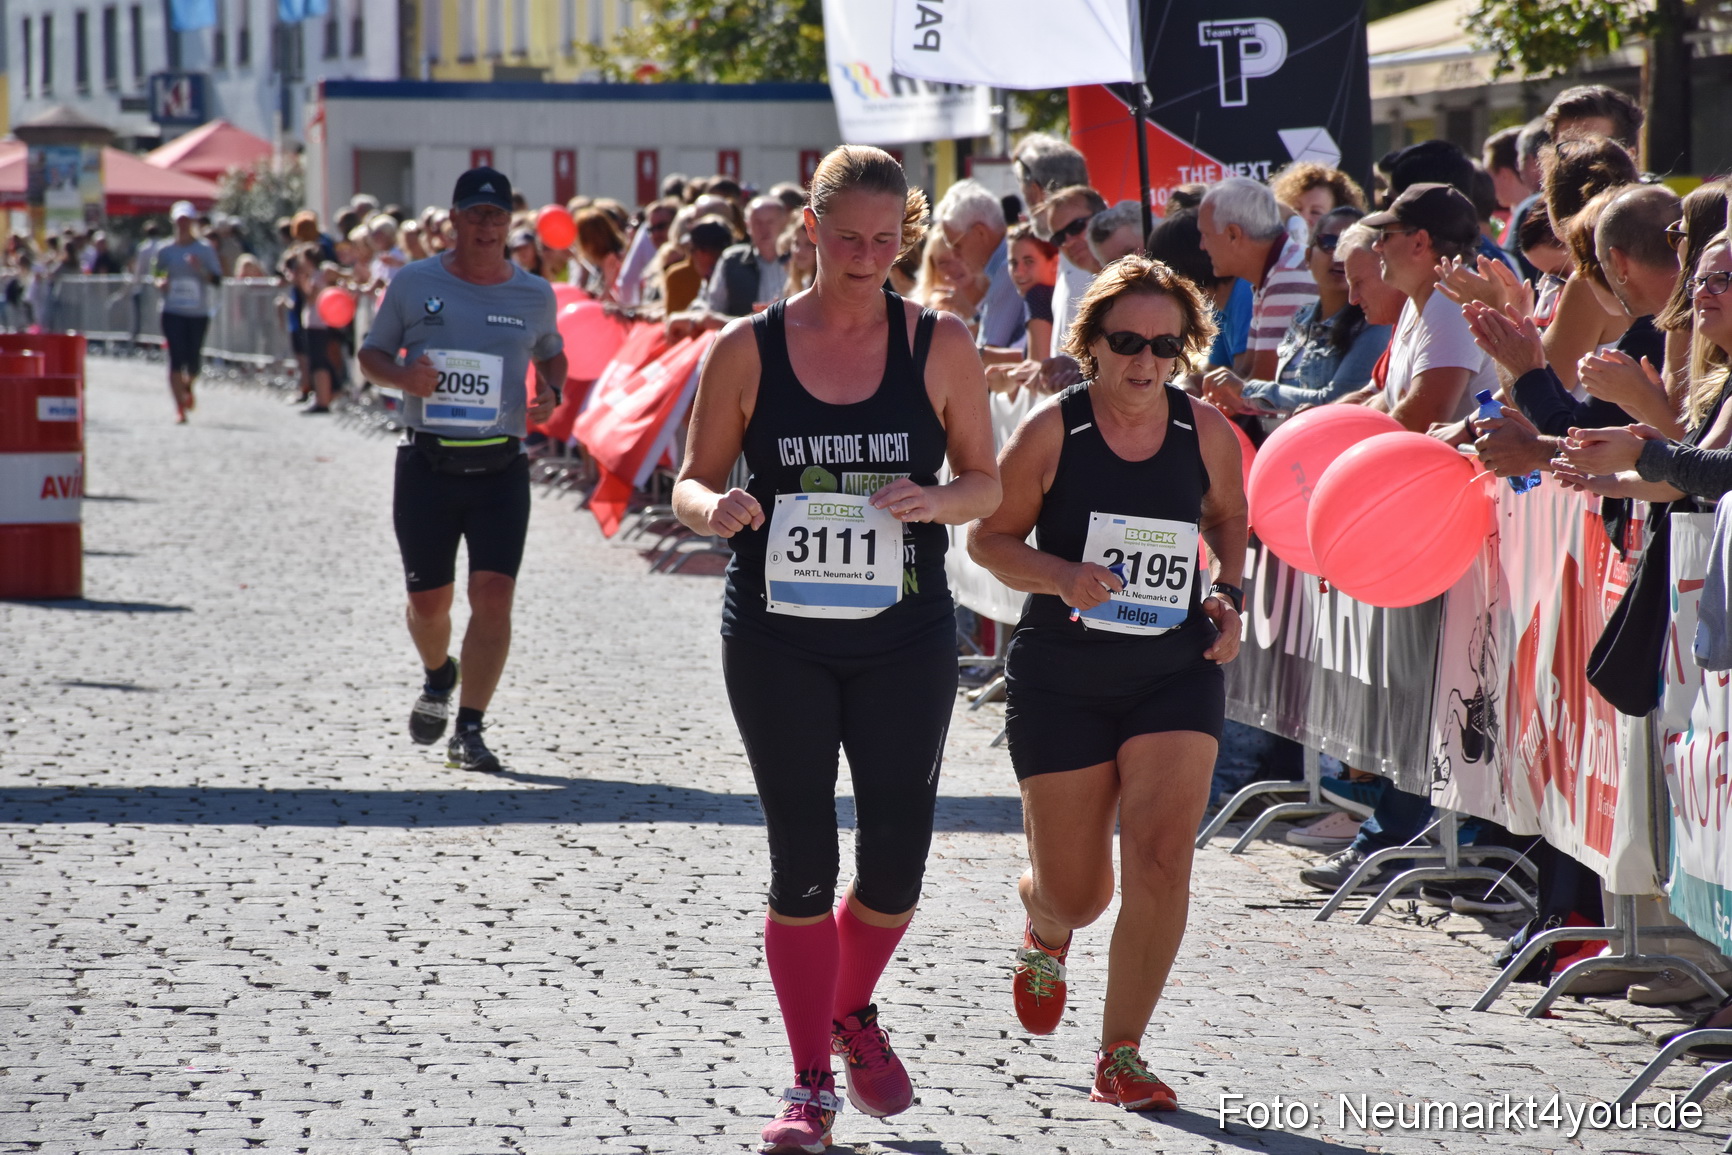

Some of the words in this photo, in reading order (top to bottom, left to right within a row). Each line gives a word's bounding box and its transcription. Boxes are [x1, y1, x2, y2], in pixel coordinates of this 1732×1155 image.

[1177, 164, 1216, 184] THE
[487, 315, 524, 326] BOCK
[435, 371, 490, 396] 2095
[778, 437, 806, 466] ICH
[808, 434, 864, 464] WERDE
[868, 432, 909, 462] NICHT
[808, 503, 864, 518] BOCK
[786, 526, 876, 565] 3111
[1125, 528, 1177, 544] BOCK
[794, 569, 821, 578] PARTL
[823, 570, 862, 579] Neumarkt
[1103, 548, 1189, 590] 2195
[1132, 591, 1167, 601] Neumarkt
[1117, 605, 1158, 626] Helga
